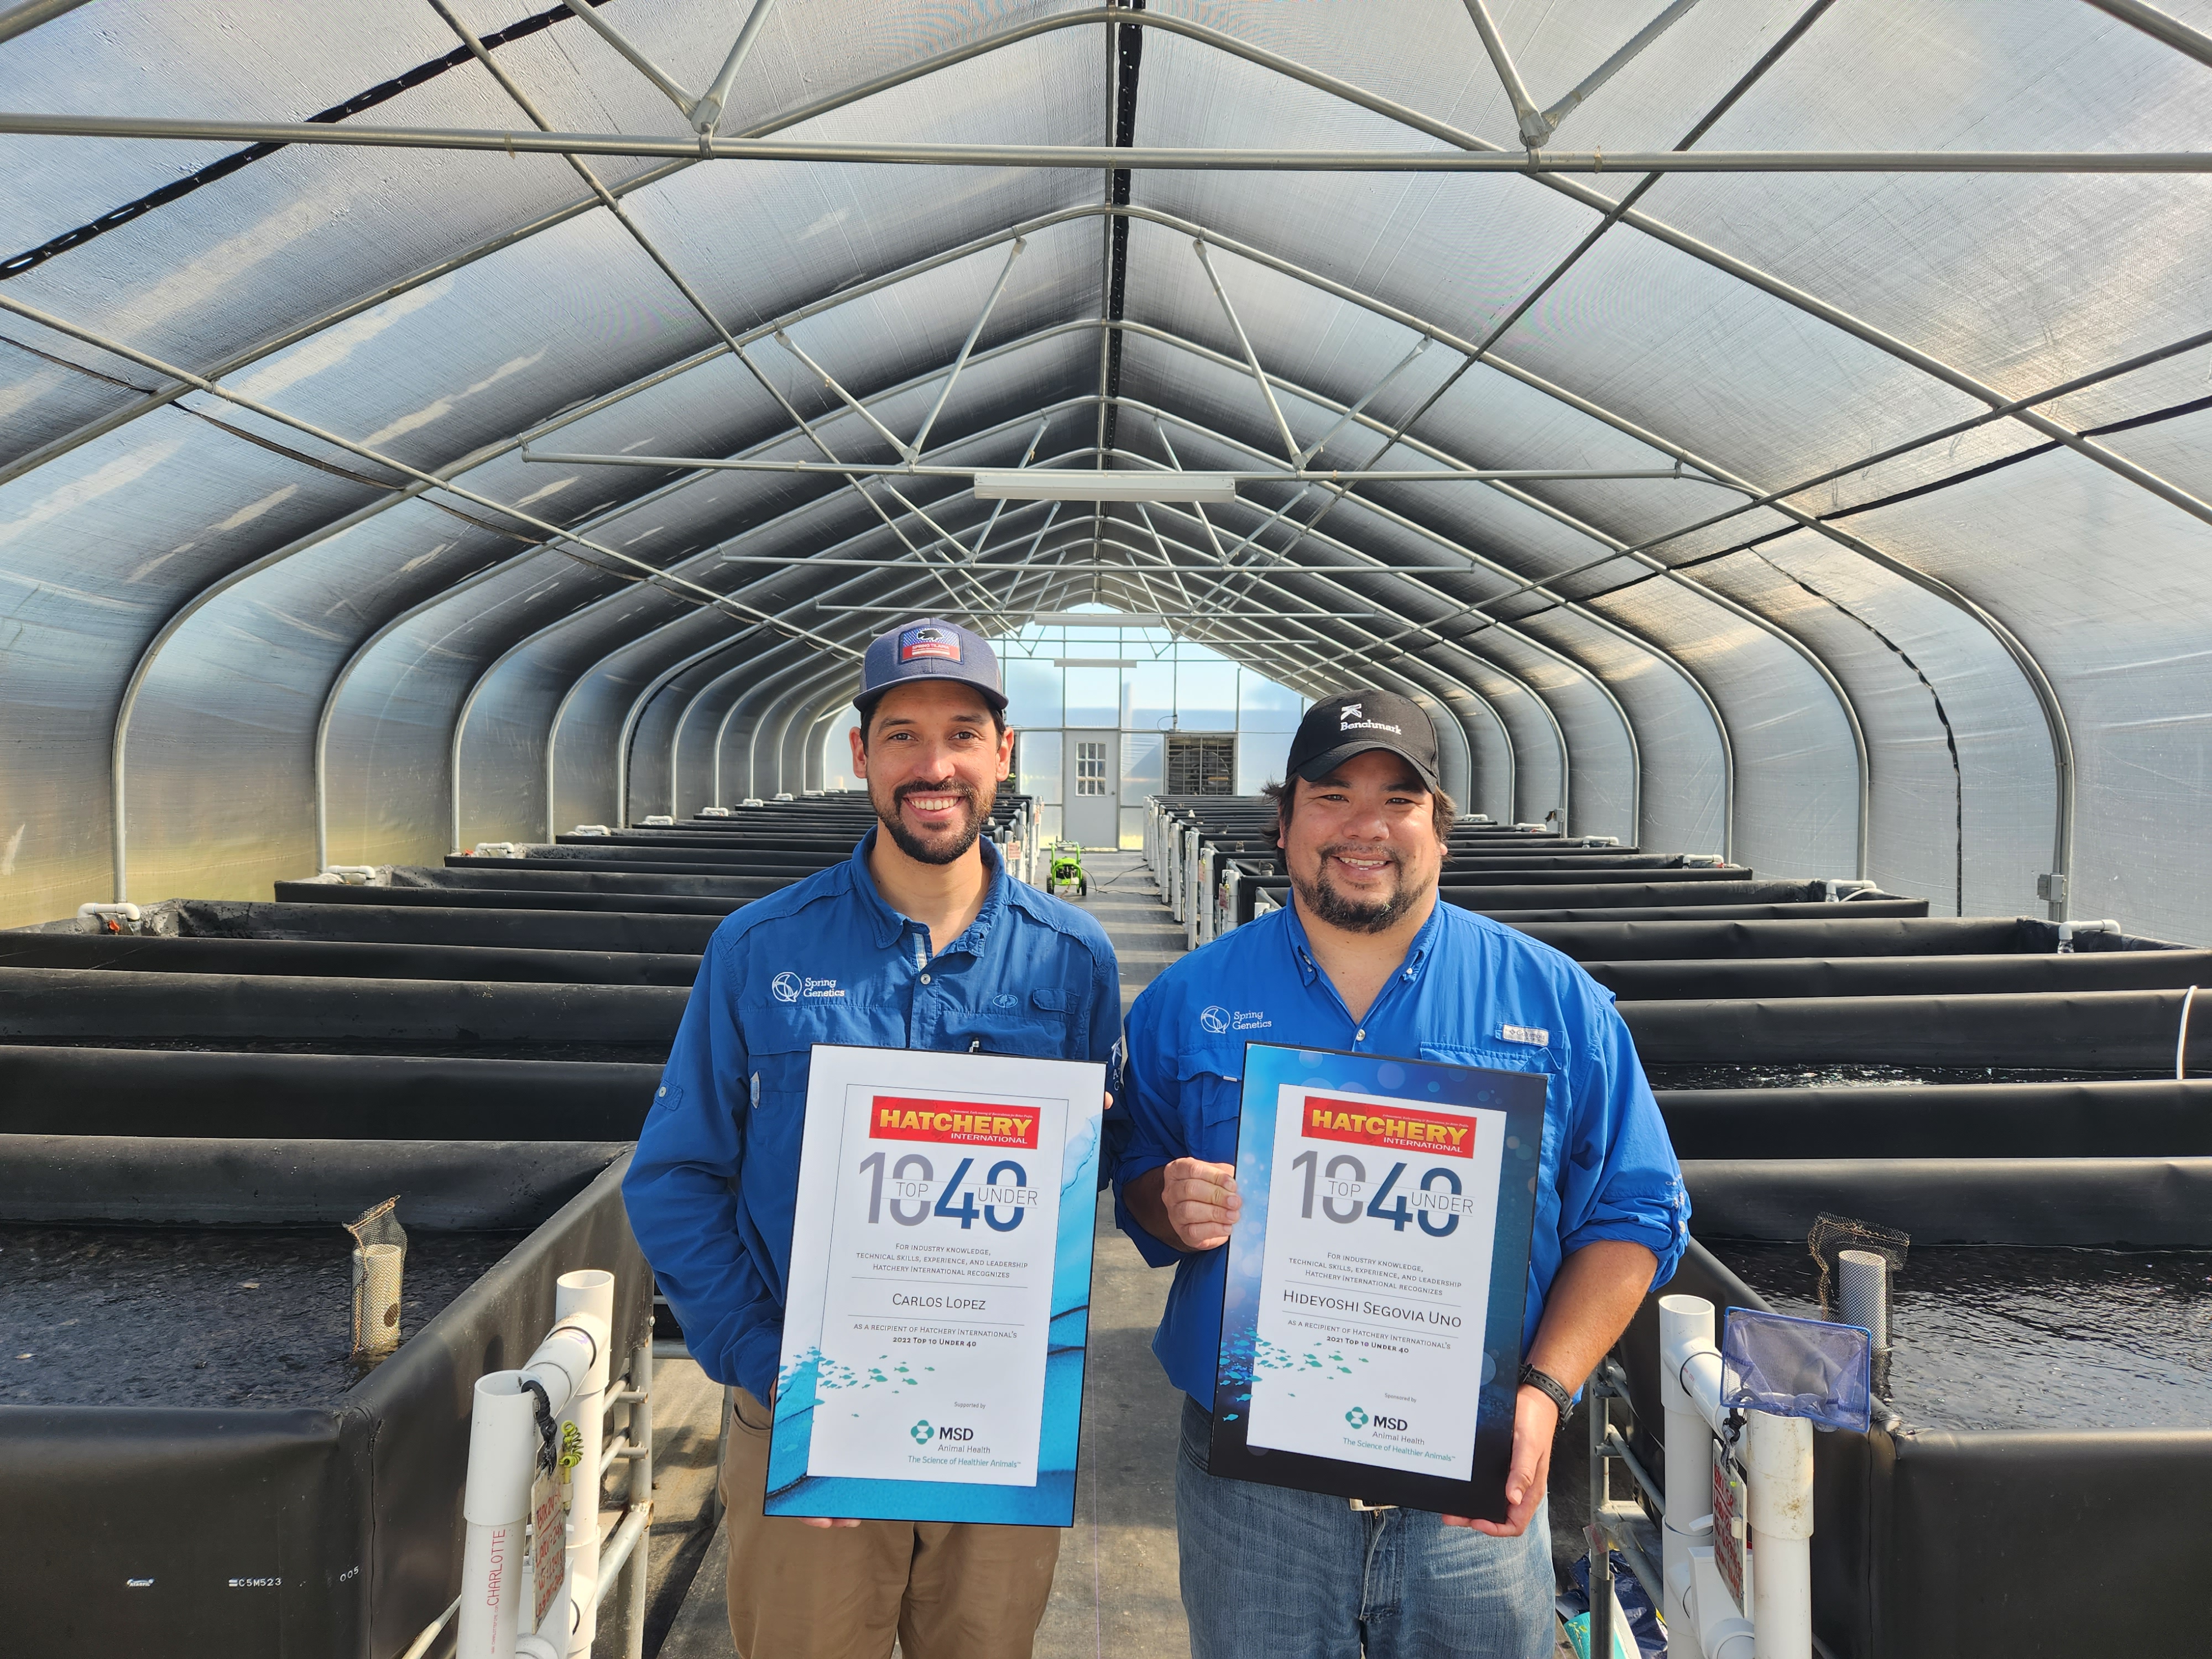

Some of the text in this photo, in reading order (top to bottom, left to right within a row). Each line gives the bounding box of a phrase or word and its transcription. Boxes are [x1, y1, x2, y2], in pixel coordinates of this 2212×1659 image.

[1340, 719, 1401, 735] Benchmark
[805, 977, 837, 988] Spring
[804, 988, 845, 997] Genetics
[1234, 1010, 1263, 1021] Spring
[1232, 1020, 1272, 1030] Genetics
[880, 1109, 1032, 1136] HATCHERY
[1312, 1109, 1468, 1146] HATCHERY
[951, 1133, 1027, 1144] INTERNATIONAL
[1384, 1137, 1463, 1152] INTERNATIONAL
[859, 1152, 1026, 1232] 10 40
[896, 1181, 1037, 1206] TOP UNDER
[1292, 1150, 1462, 1238] 10 40
[1328, 1180, 1473, 1213] TOP UNDER
[947, 1248, 991, 1256] KNOWLEDGE,
[924, 1256, 967, 1265] EXPERIENCE,
[1343, 1255, 1376, 1265] INDUSTRY
[1378, 1260, 1423, 1272] KNOWLEDGE,
[873, 1264, 909, 1272] HATCHERY
[911, 1266, 964, 1275] INTERNATIONAL
[1289, 1258, 1327, 1269] TECHNICAL
[1328, 1264, 1353, 1272] SKILLS,
[1355, 1267, 1399, 1280] EXPERIENCE,
[1419, 1276, 1462, 1287] LEADERSHIP
[1305, 1270, 1442, 1295] HATCHERY INTERNATIONAL RECOGNIZES
[893, 1293, 986, 1310] CARLOS LOPEZ
[1283, 1290, 1462, 1327] HIDEYOSHI SEGOVIA UNO
[920, 1326, 956, 1335] HATCHERY
[1305, 1322, 1340, 1332] RECIPIENT
[1353, 1328, 1389, 1339] HATCHERY
[1371, 1342, 1397, 1352] UNDER
[1385, 1392, 1410, 1401] Sponsored
[1374, 1415, 1408, 1431] MSD
[939, 1427, 973, 1441] MSD
[1372, 1431, 1425, 1446] Animal Health
[967, 1446, 990, 1454] Health
[1343, 1437, 1355, 1446] The
[1357, 1440, 1382, 1450] Science
[1392, 1446, 1423, 1457] Healthier
[922, 1456, 948, 1464] Science
[958, 1458, 989, 1467] Healthier
[487, 1529, 505, 1606] CHARLOTTE
[238, 1577, 282, 1587] C5M523
